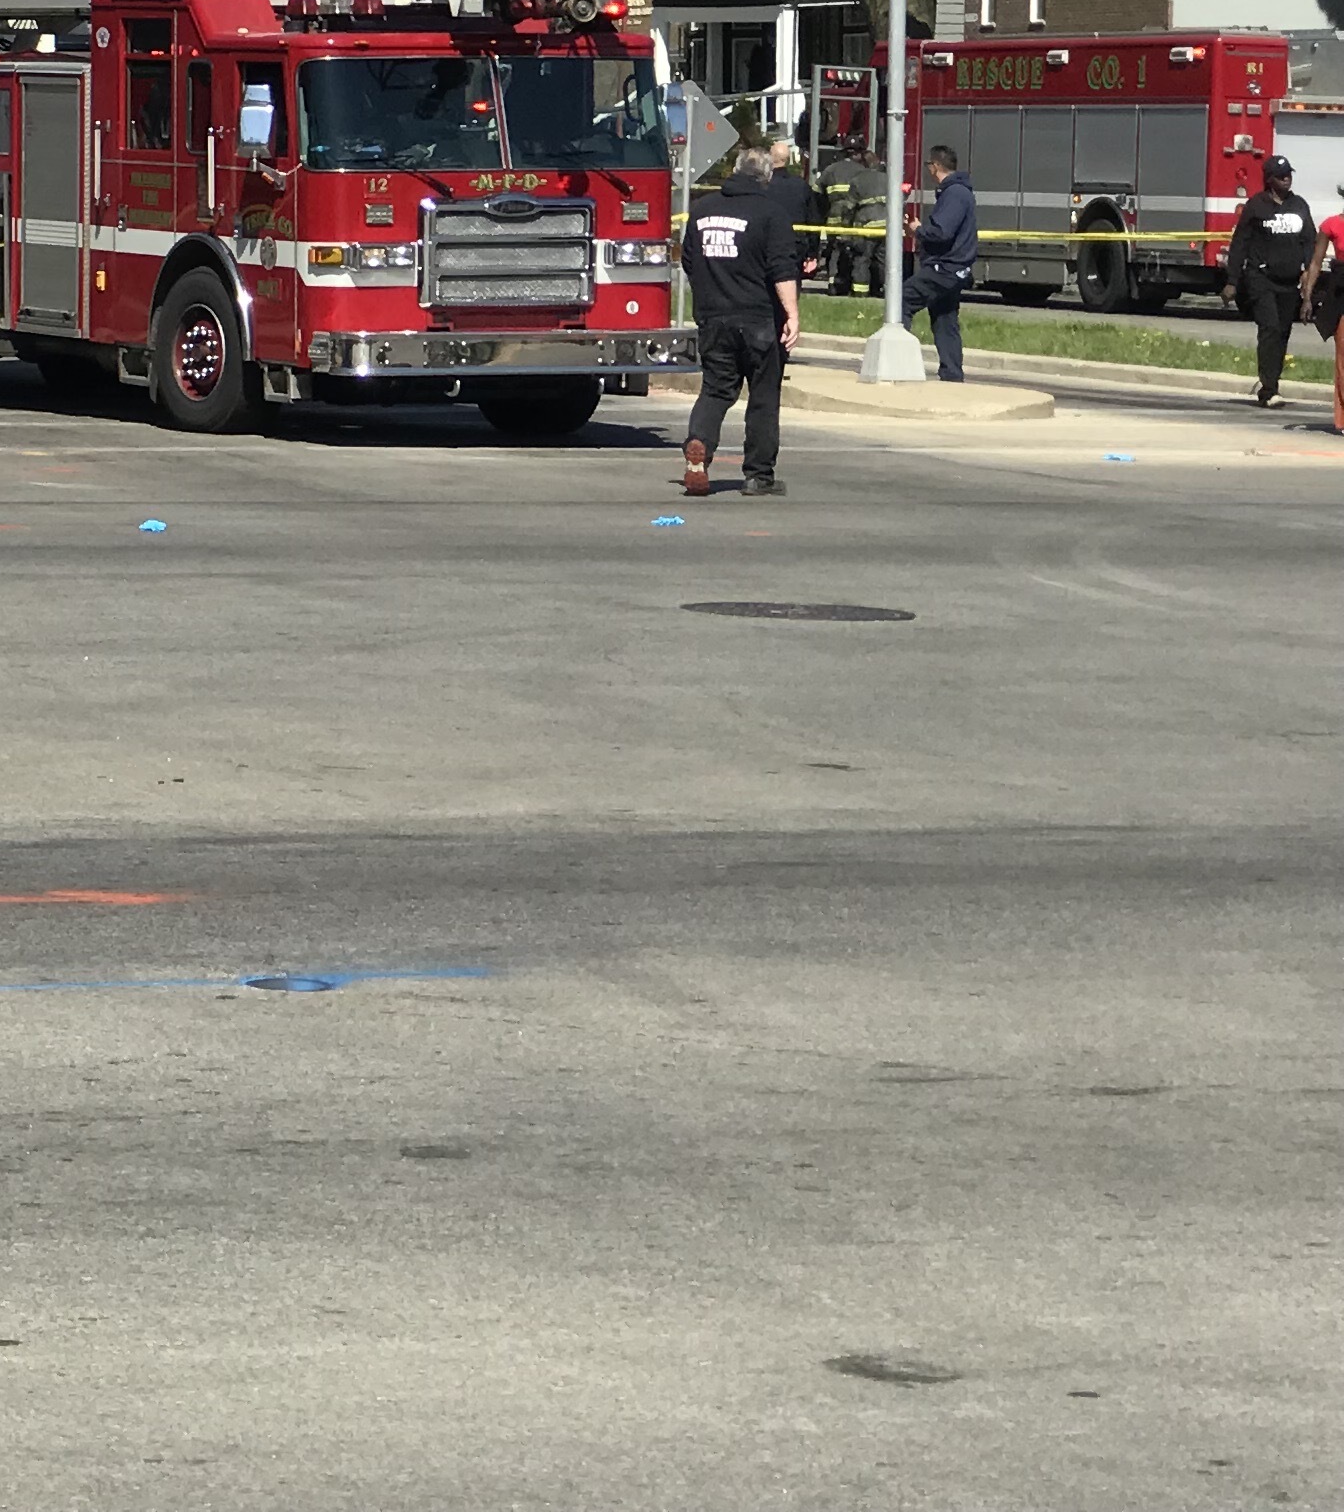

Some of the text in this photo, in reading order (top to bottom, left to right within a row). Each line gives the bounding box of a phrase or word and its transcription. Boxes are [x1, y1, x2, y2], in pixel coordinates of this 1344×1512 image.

[956, 55, 1147, 90] RESCUE CO. 1
[368, 178, 389, 193] 12
[702, 230, 736, 245] FIRE
